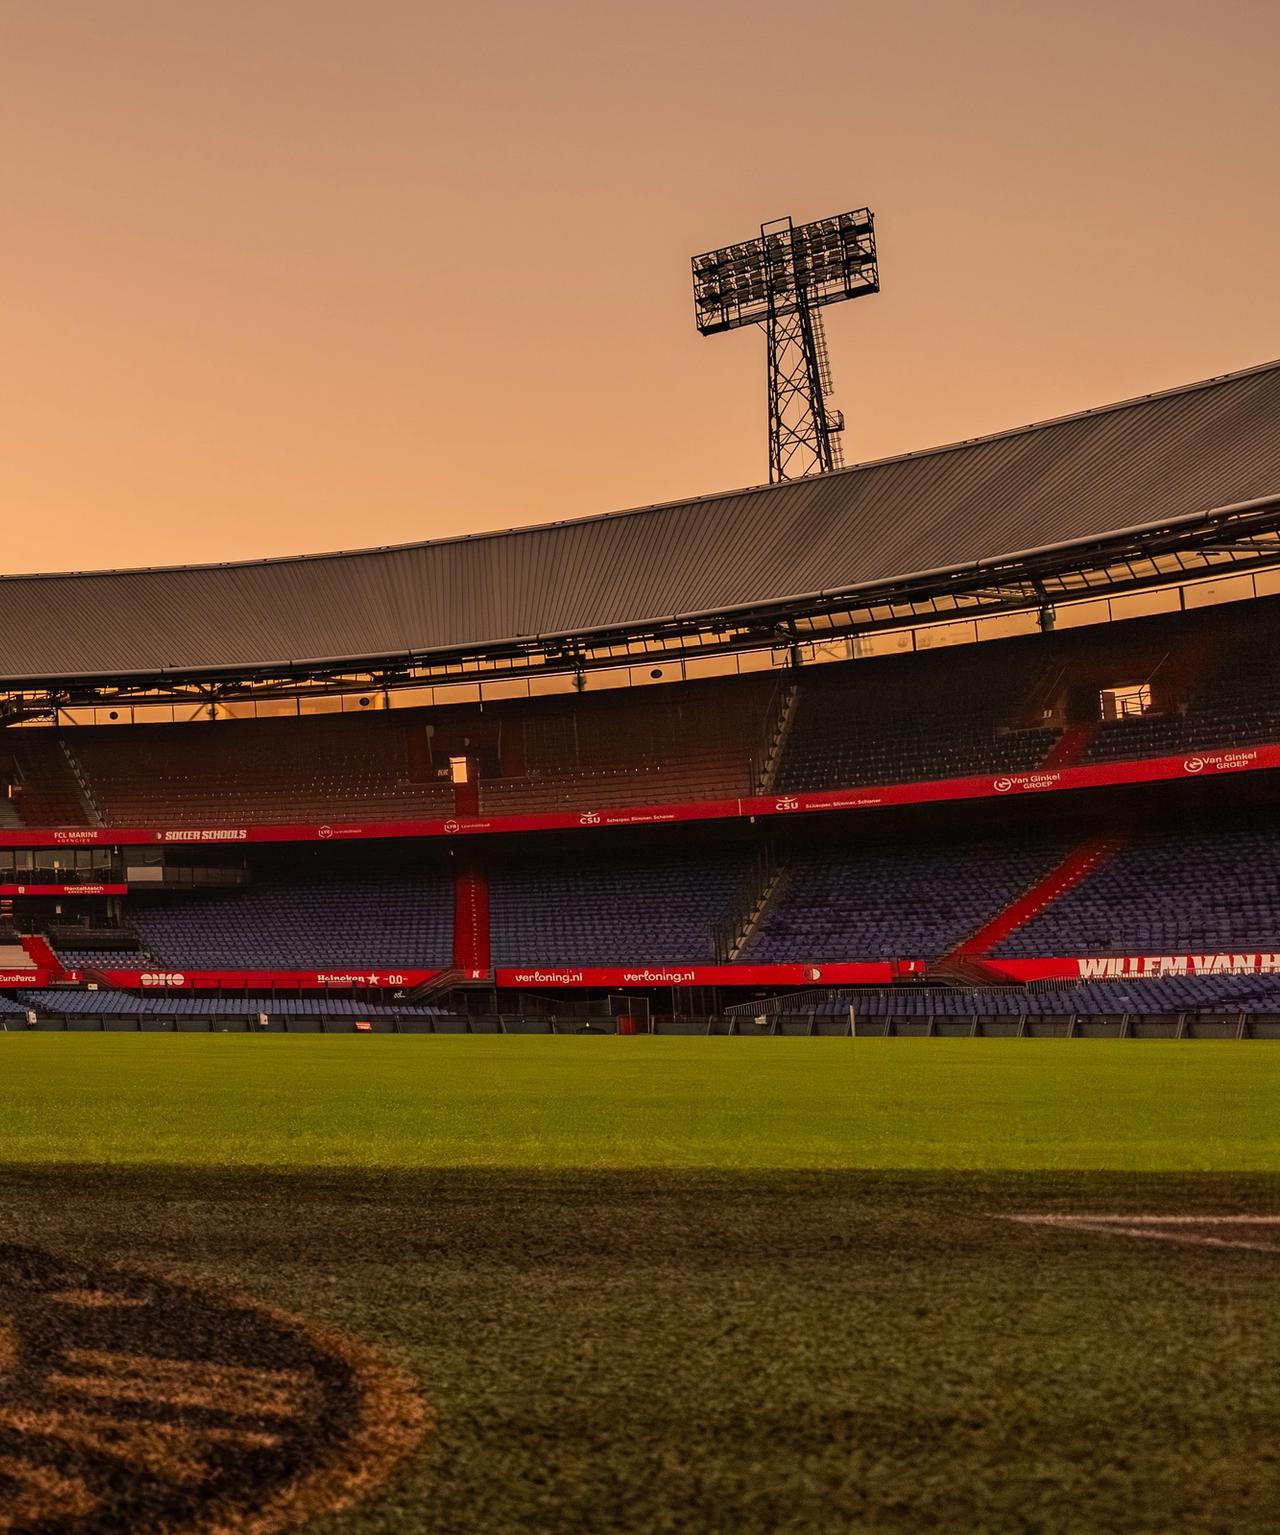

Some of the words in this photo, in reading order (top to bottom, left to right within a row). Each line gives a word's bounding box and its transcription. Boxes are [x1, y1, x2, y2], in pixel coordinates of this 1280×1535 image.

[1203, 755, 1223, 765] Van
[1224, 752, 1257, 763] Ginkel
[1217, 761, 1249, 770] GROEP
[1010, 776, 1029, 785] Van
[1030, 773, 1061, 783] Ginkel
[1023, 781, 1053, 789] GROEP
[776, 802, 799, 810] CSU
[54, 831, 68, 839] FCL
[69, 830, 98, 839] MARINE
[165, 831, 201, 841] SOCCER
[202, 830, 247, 840] SCHOOLS
[1077, 957, 1188, 979] WILLEM
[1191, 954, 1256, 976] VAN
[317, 974, 365, 983] Heineken
[472, 970, 480, 978] K
[515, 971, 583, 983] verloning.nl
[623, 971, 695, 983] verloning.nl
